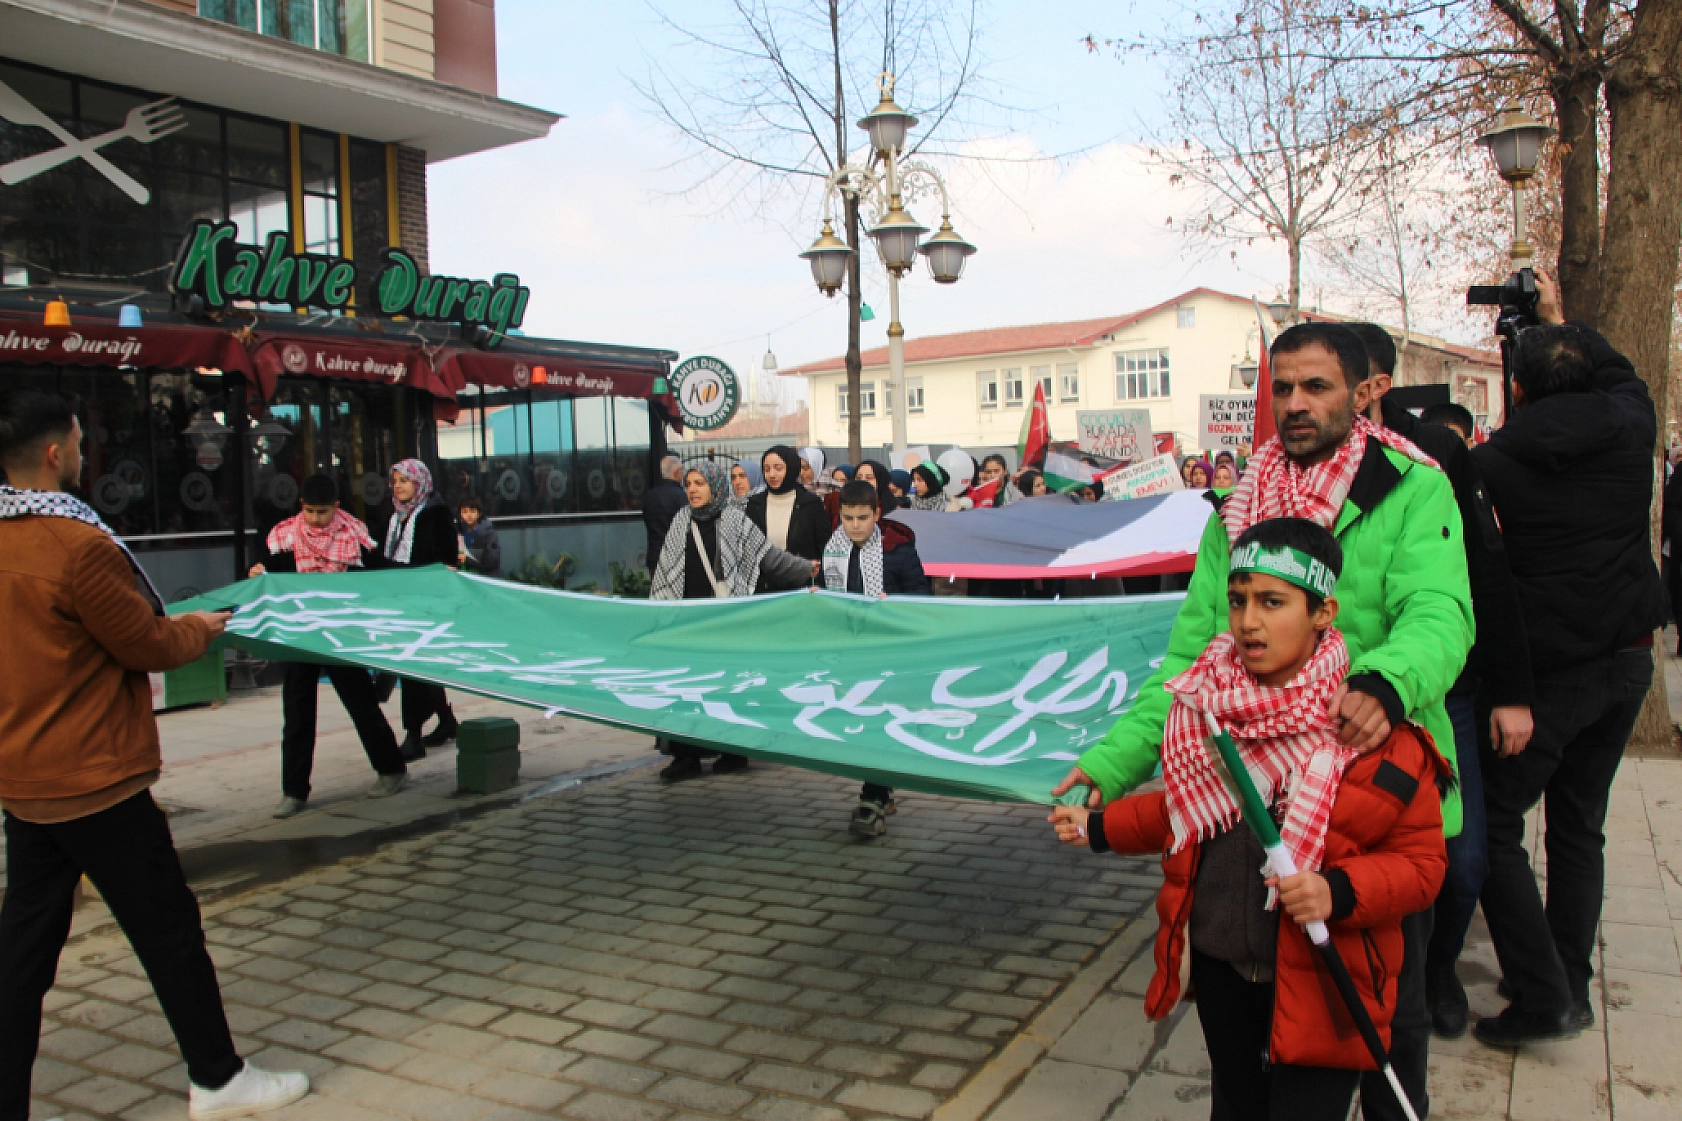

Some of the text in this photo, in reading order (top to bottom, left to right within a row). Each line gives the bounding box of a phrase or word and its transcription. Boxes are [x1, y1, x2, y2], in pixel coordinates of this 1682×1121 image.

[177, 223, 529, 347] Kahve Durağı
[0, 329, 142, 361] ahve Durağı
[315, 351, 361, 371] Kahve
[546, 371, 573, 386] ahve
[1228, 399, 1256, 411] OYNA
[1236, 410, 1255, 422] DEĞ
[1092, 434, 1137, 450] ZAFER
